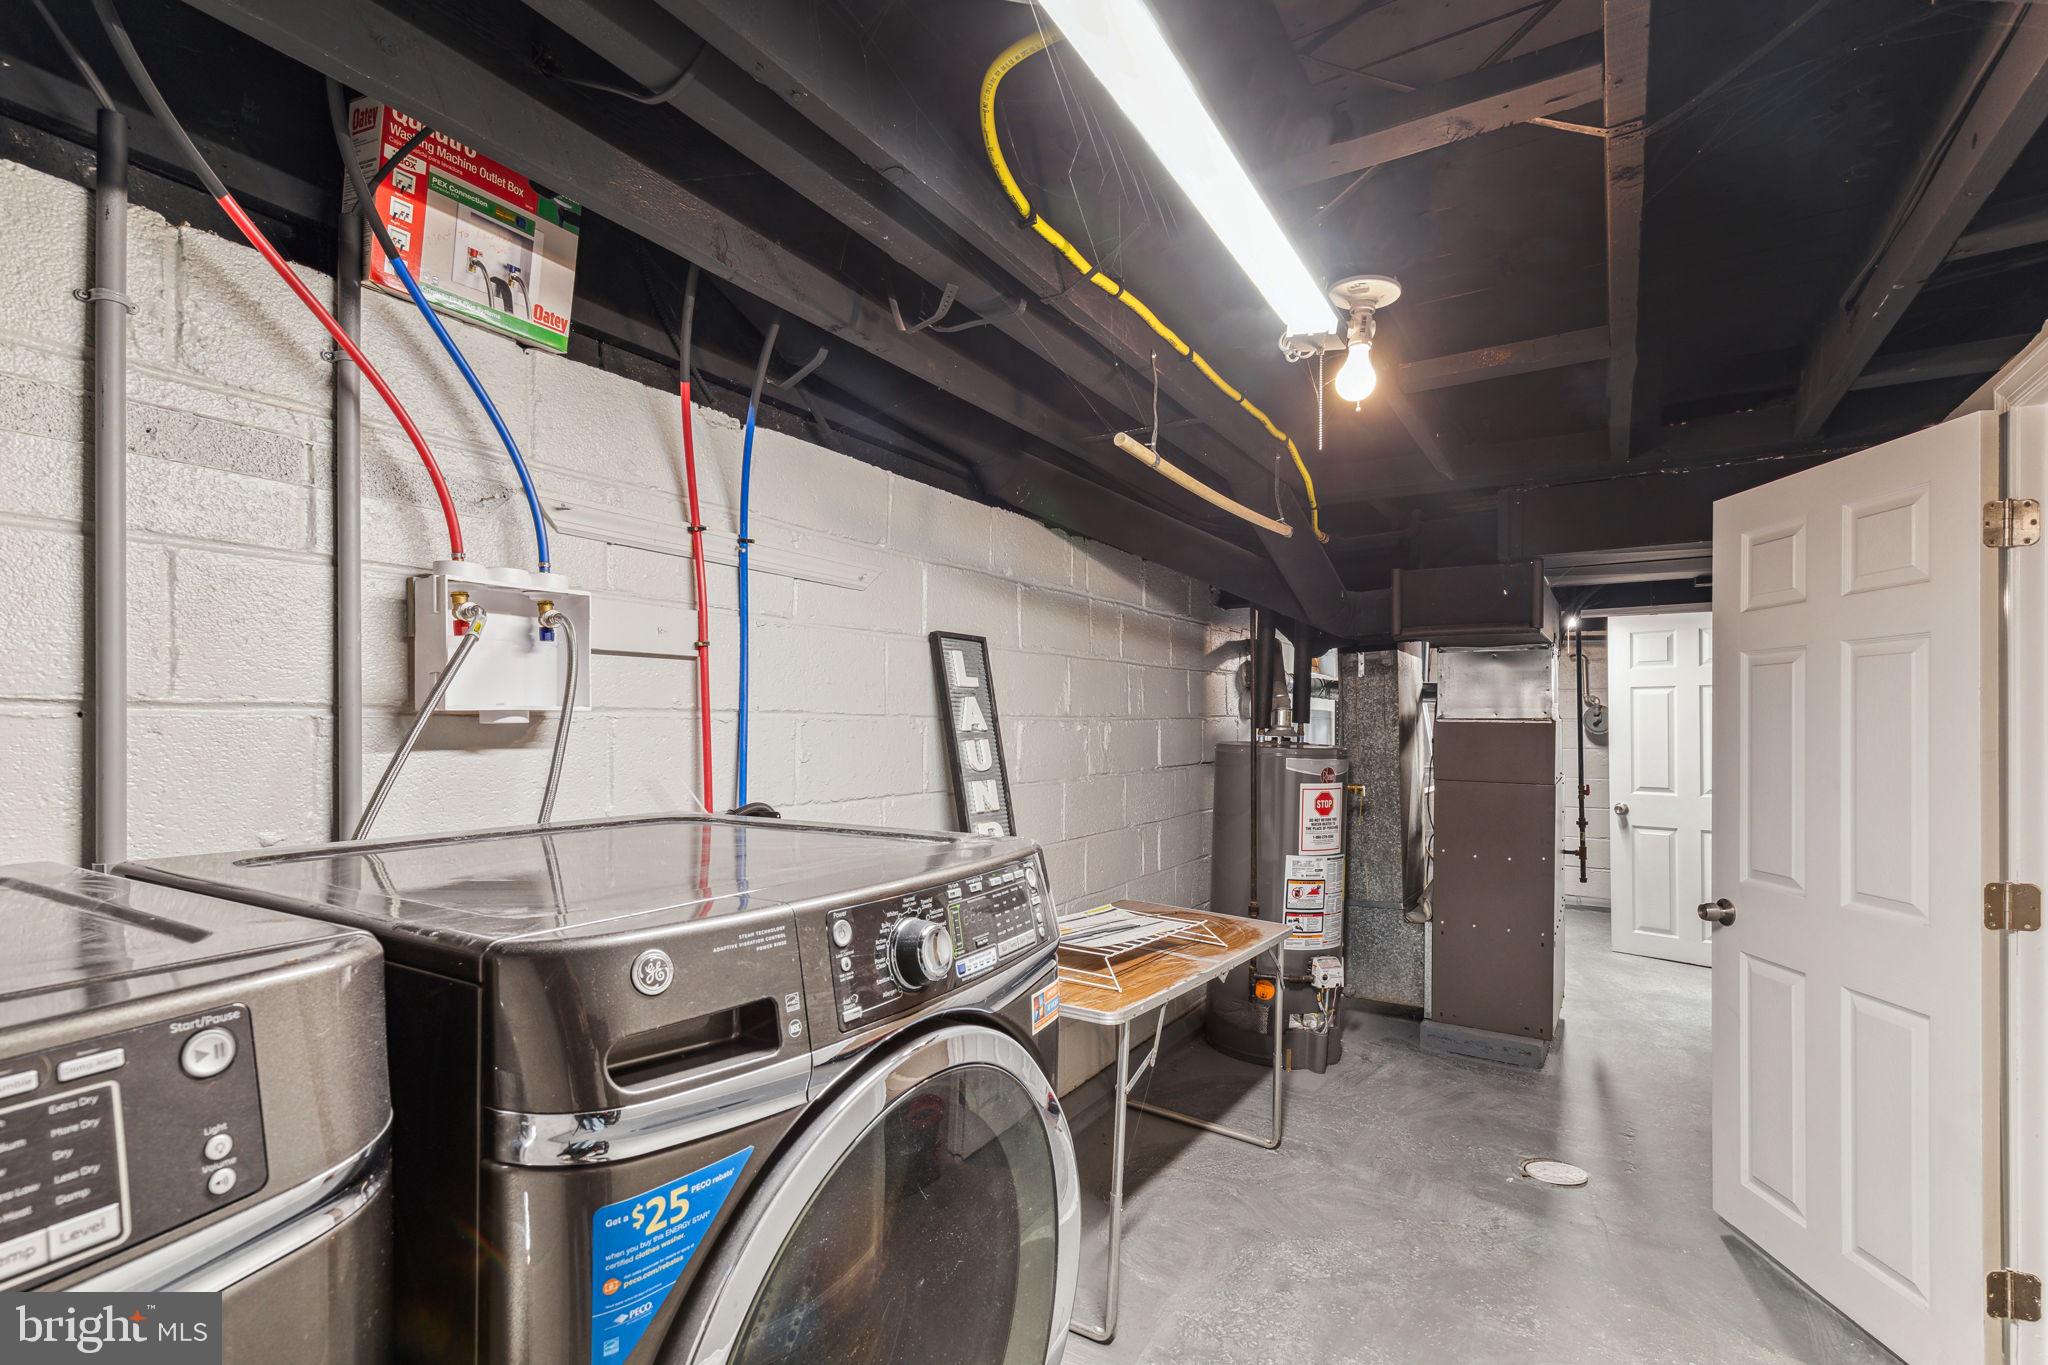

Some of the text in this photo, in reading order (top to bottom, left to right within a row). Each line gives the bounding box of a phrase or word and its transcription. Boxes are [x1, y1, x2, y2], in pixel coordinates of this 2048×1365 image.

[352, 106, 379, 131] Oatey
[436, 147, 478, 174] Machine
[480, 167, 506, 189] Outlet
[507, 180, 524, 198] Box
[432, 176, 488, 208] PEX Connection
[533, 304, 569, 332] Oatey
[1316, 799, 1333, 809] STOP
[833, 911, 847, 919] Power
[738, 925, 786, 940] STEAM TECHNOLOGY
[713, 943, 738, 953] ADAPTIVE
[756, 944, 773, 952] POWER
[169, 1009, 241, 1035] Start/Pause
[48, 1094, 100, 1115] Extra Dry
[80, 1116, 101, 1130] Dry
[203, 1121, 228, 1137] Light
[51, 1147, 75, 1162] Dry
[201, 1155, 237, 1174] Volume
[79, 1163, 101, 1177] Dry
[54, 1186, 92, 1206] Damp
[605, 1216, 622, 1229] Get
[622, 1215, 629, 1223] a
[631, 1183, 690, 1236] $25
[690, 1177, 711, 1193] PECO
[58, 1216, 107, 1245] Level
[604, 1249, 624, 1261] when
[625, 1243, 639, 1258] you
[639, 1237, 652, 1251] buy
[652, 1232, 665, 1244] this
[665, 1220, 691, 1237] ENERGY
[604, 1255, 634, 1271] certified
[634, 1243, 660, 1260] clothes
[622, 1255, 684, 1289] peco.com/rebates
